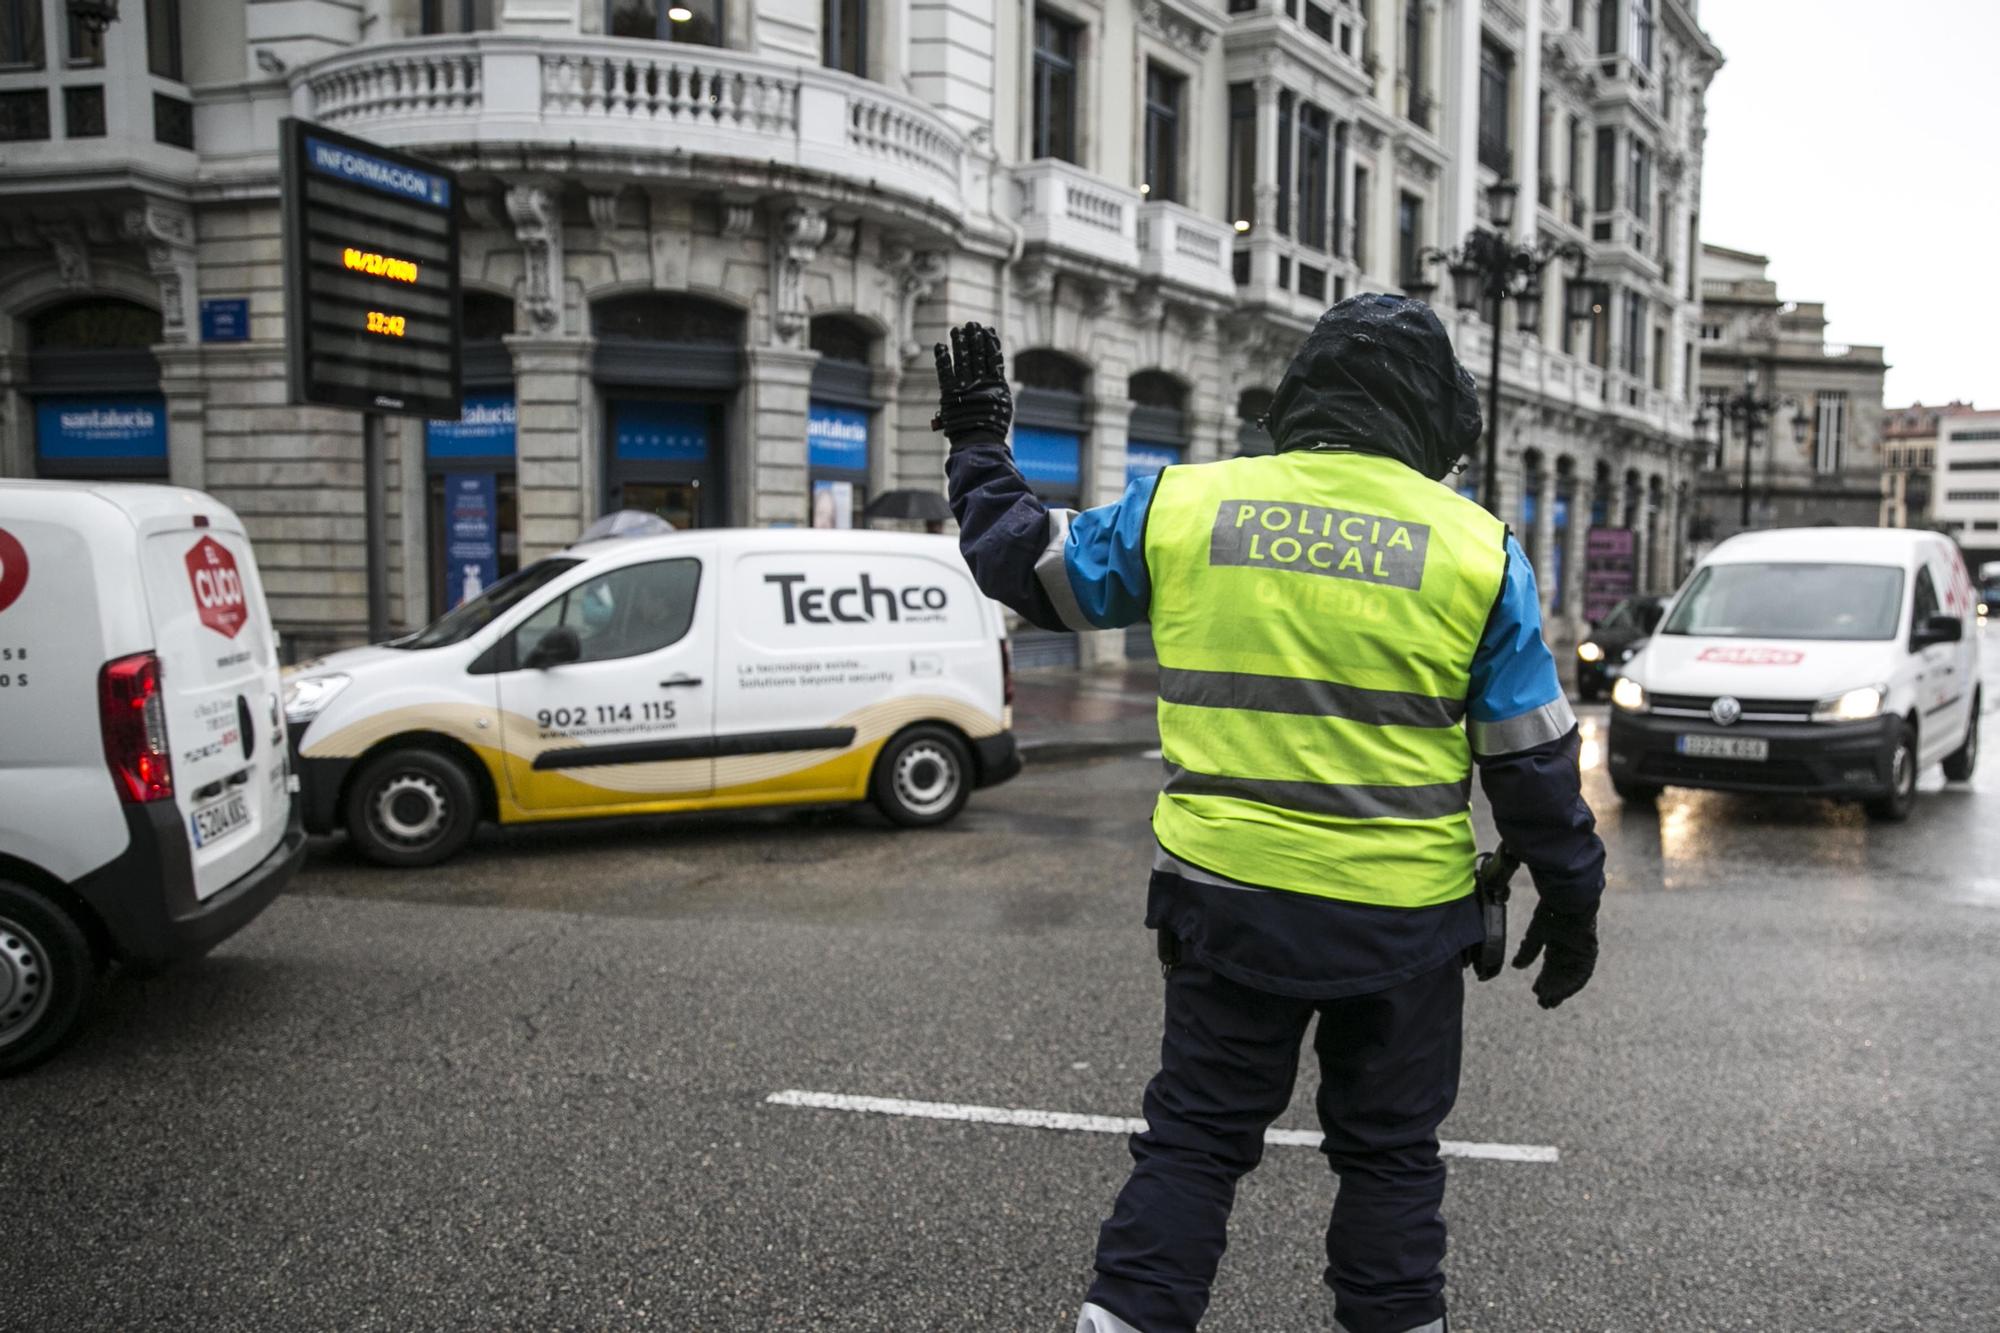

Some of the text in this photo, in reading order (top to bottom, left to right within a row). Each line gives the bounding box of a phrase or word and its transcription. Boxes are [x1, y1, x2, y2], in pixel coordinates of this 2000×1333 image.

[316, 146, 427, 197] INFORMACIÓN
[1235, 505, 1413, 551] POLICIA
[1249, 534, 1389, 577] LOCAL
[537, 701, 676, 728] 902 114 115
